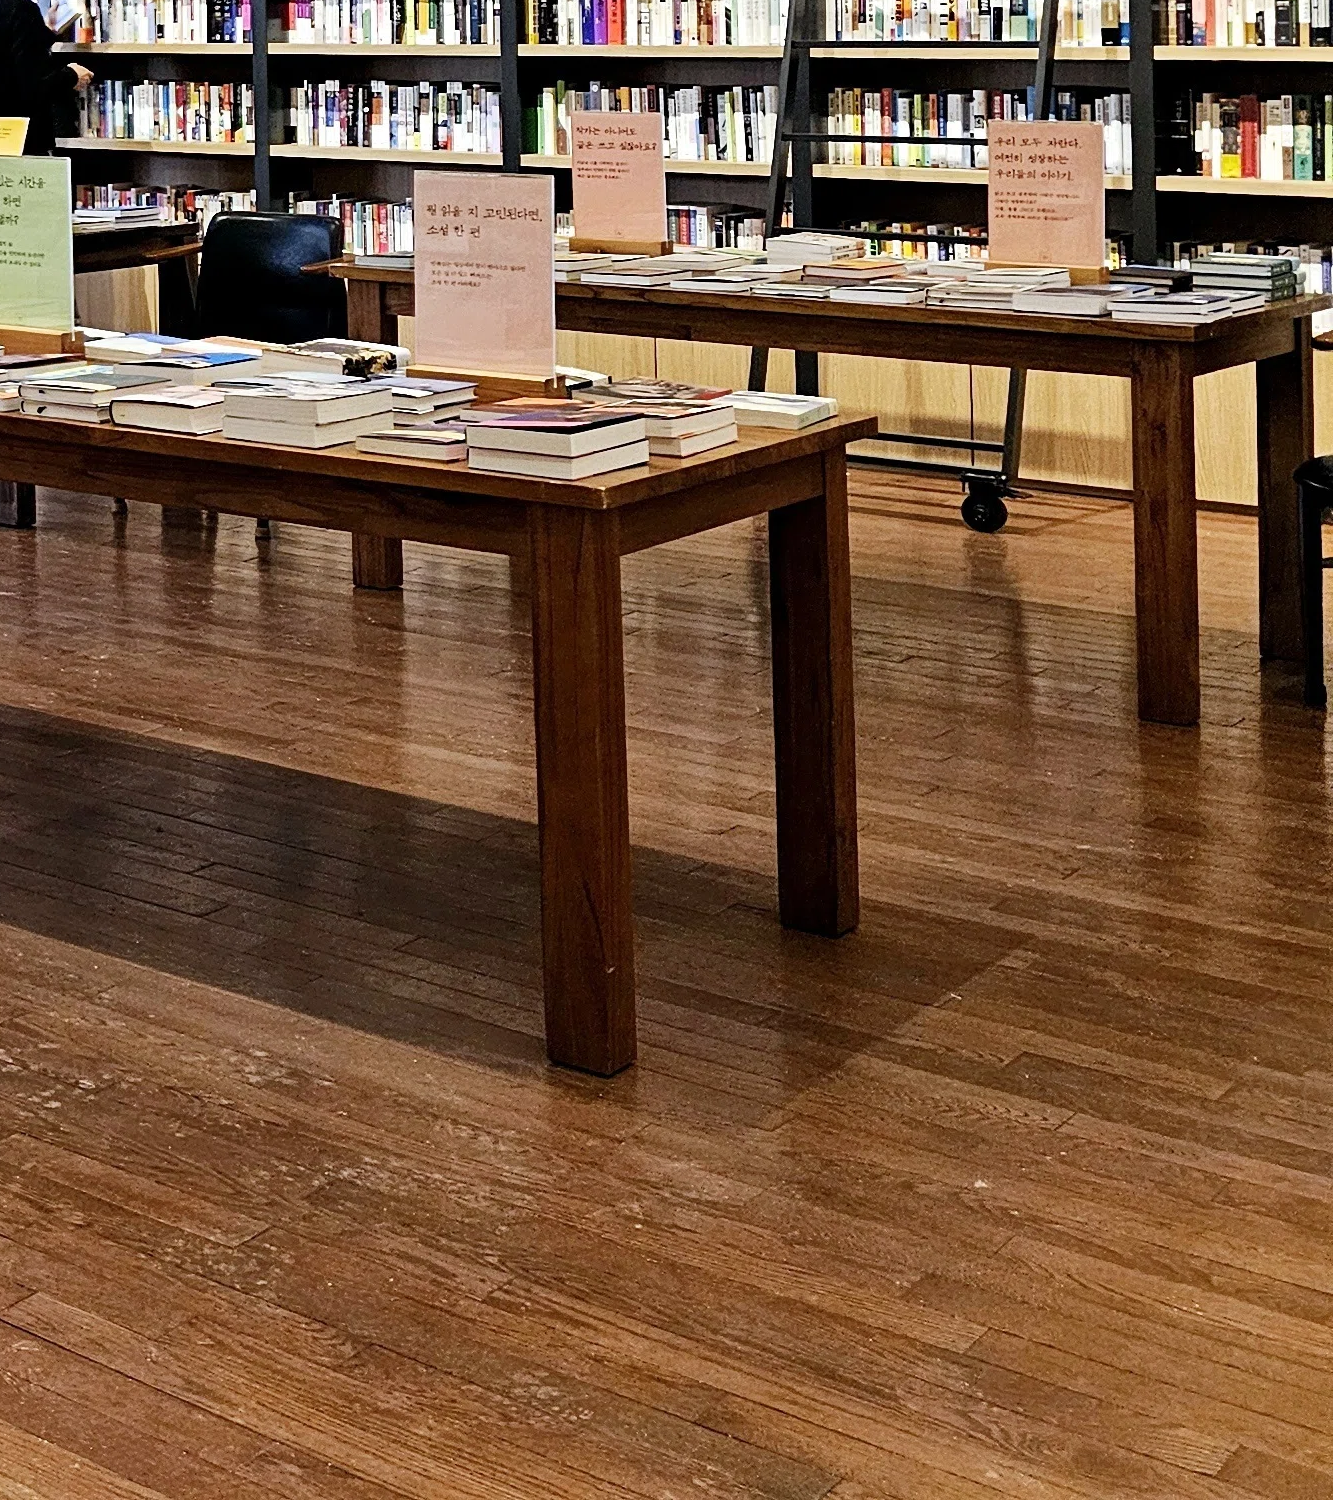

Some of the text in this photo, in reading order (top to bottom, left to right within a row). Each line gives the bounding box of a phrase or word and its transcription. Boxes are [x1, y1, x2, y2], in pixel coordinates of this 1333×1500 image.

[576, 126, 637, 136] 작가는 아니어도
[577, 141, 593, 149] 글은
[994, 137, 1015, 147] 우리
[1048, 138, 1082, 149] 자란다.
[995, 153, 1069, 164] 여전히 성장하는
[995, 169, 1036, 179] 우리들의
[19, 176, 46, 188] 시간을
[3, 195, 21, 207] 하면
[441, 204, 463, 217] 읽을
[468, 206, 478, 218] 지
[427, 224, 480, 238] 소설 한 편
